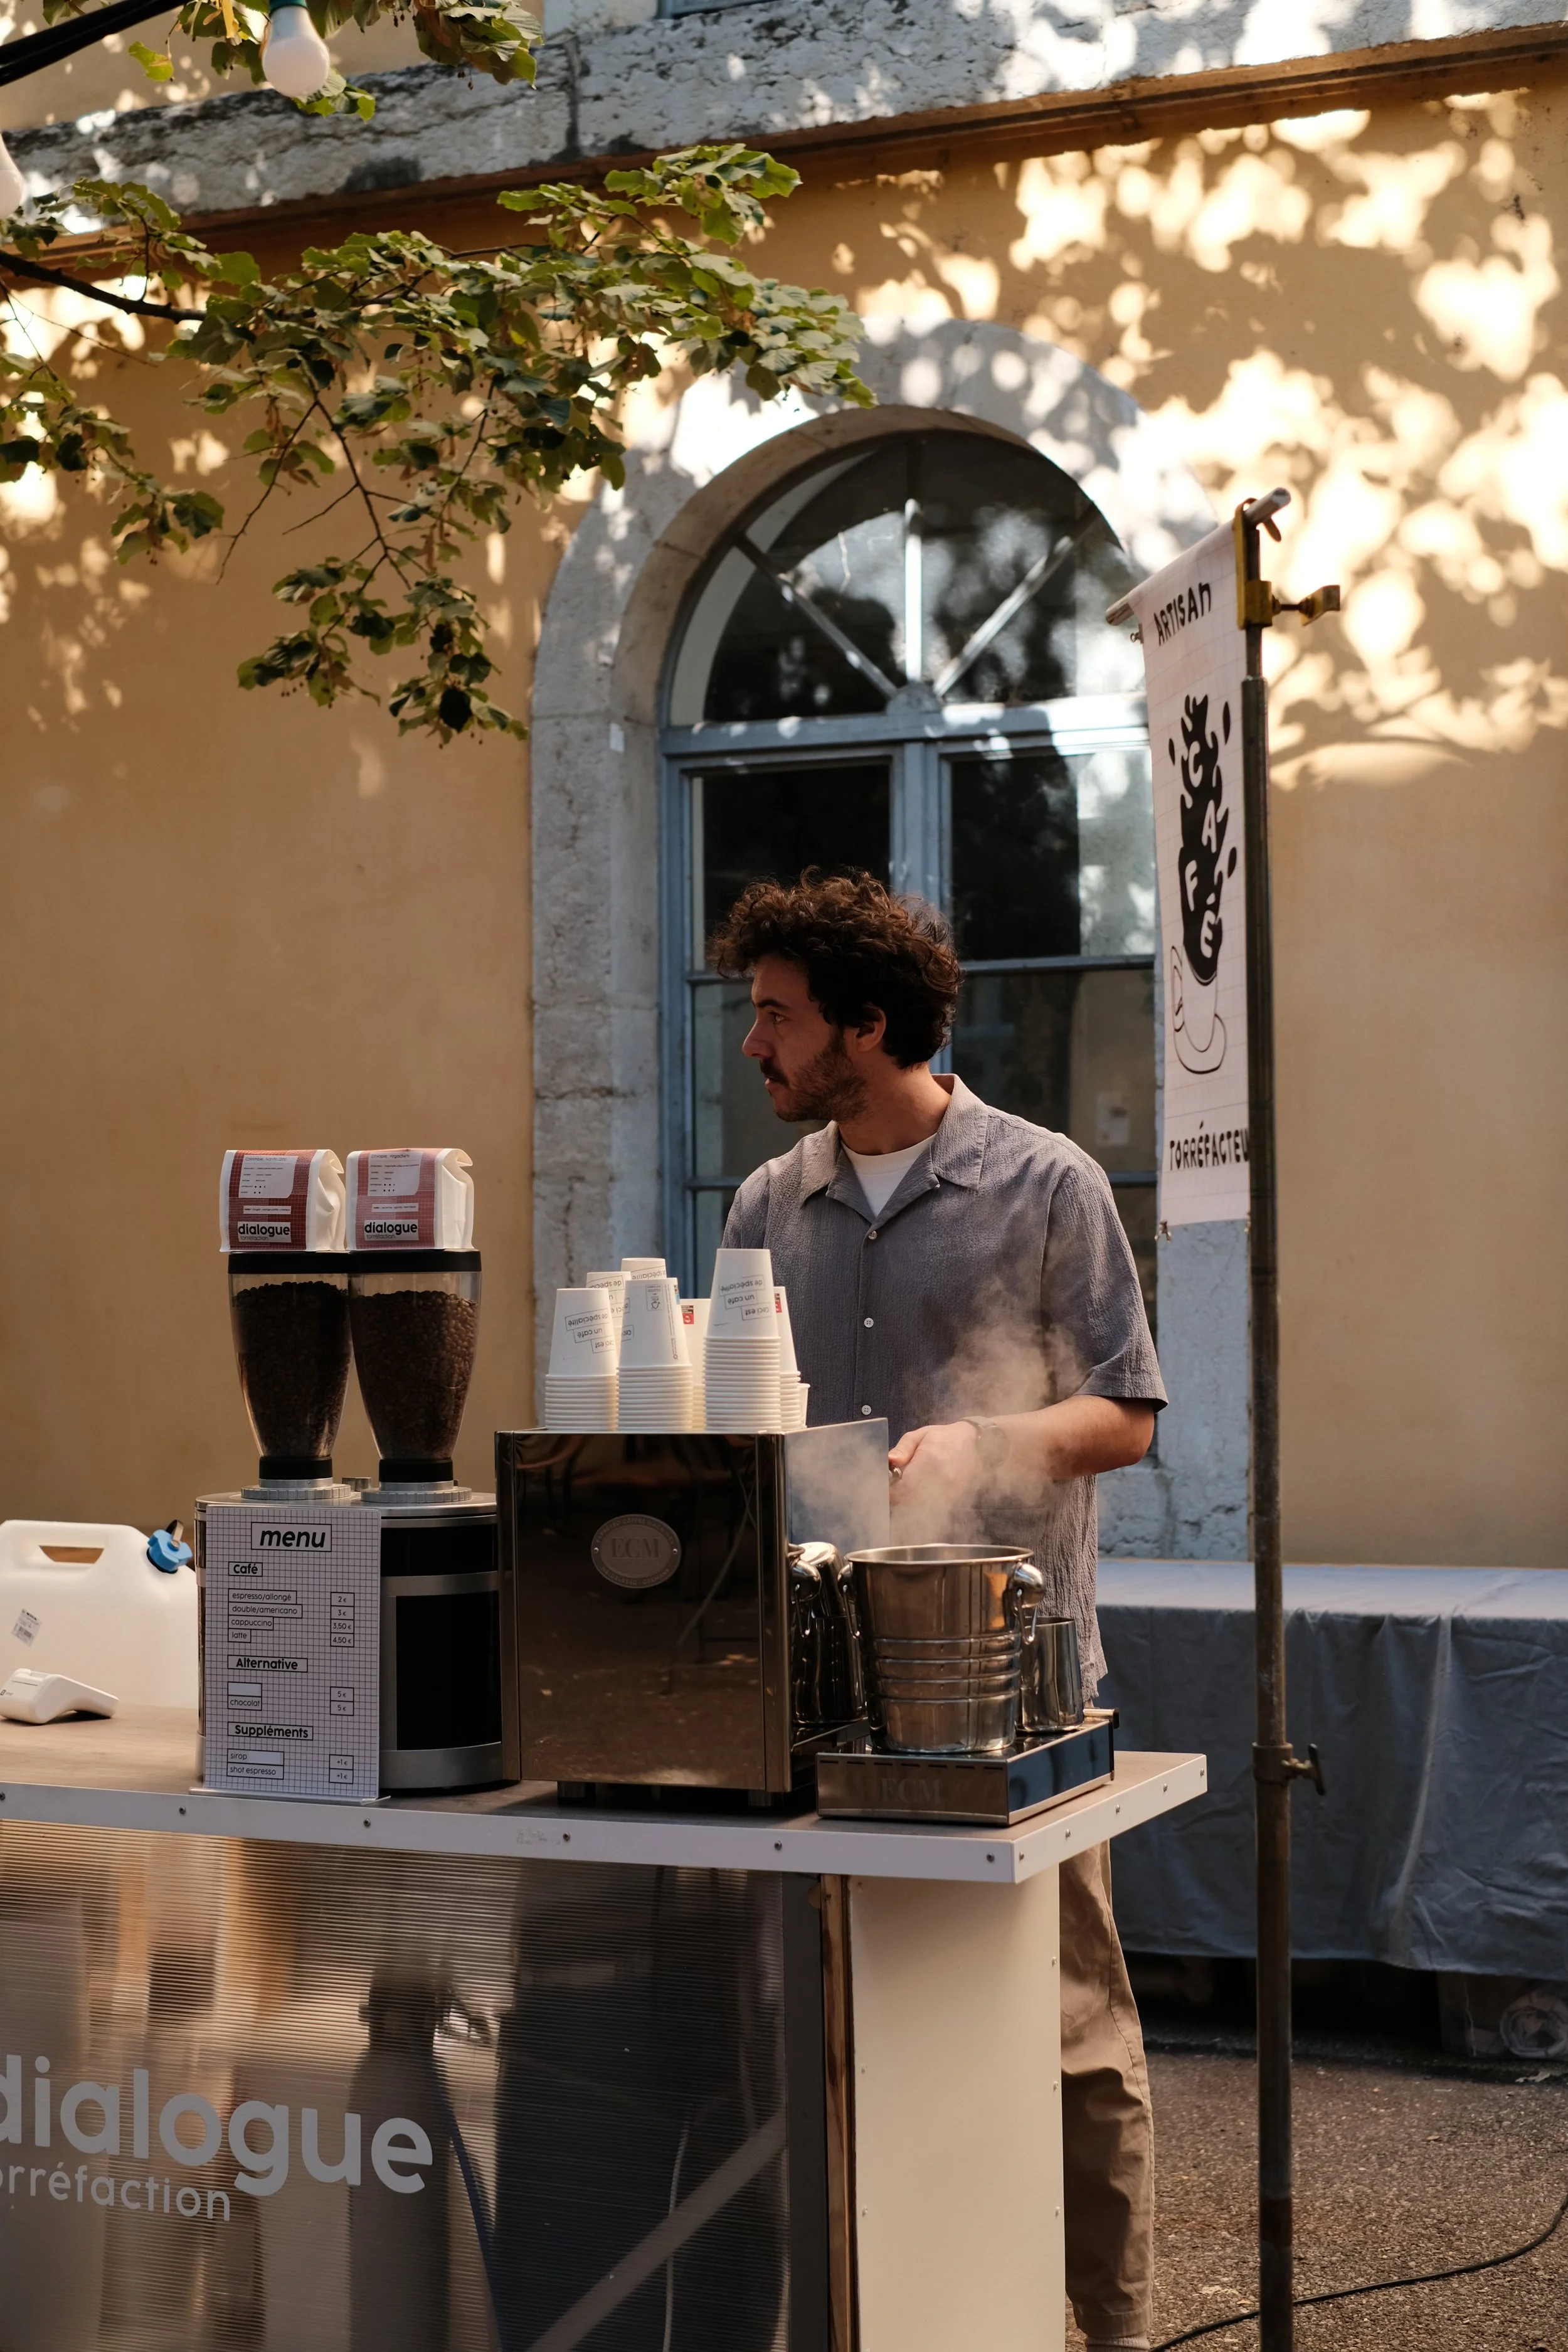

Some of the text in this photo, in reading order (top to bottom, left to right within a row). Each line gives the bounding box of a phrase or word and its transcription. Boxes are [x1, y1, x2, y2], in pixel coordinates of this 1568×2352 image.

[1170, 1120, 1250, 1171] TORRÉFACTEU
[238, 1224, 290, 1237] dialogue
[364, 1222, 418, 1236] dialogue
[728, 1296, 743, 1305] café
[568, 1314, 601, 1326] spécialité
[577, 1330, 593, 1338] café
[260, 1530, 326, 1549] menu
[610, 1537, 662, 1559] ECM
[233, 1563, 258, 1574] Café
[232, 1593, 292, 1602] espresso/allongé
[232, 1606, 298, 1614] double/americano
[236, 1657, 299, 1670] Alternative
[230, 1698, 260, 1707] chocolat
[235, 1725, 309, 1739] Suppléments
[230, 1753, 248, 1761] sirop
[879, 1778, 943, 1804] ECM
[0, 2161, 230, 2222] rréfaction
